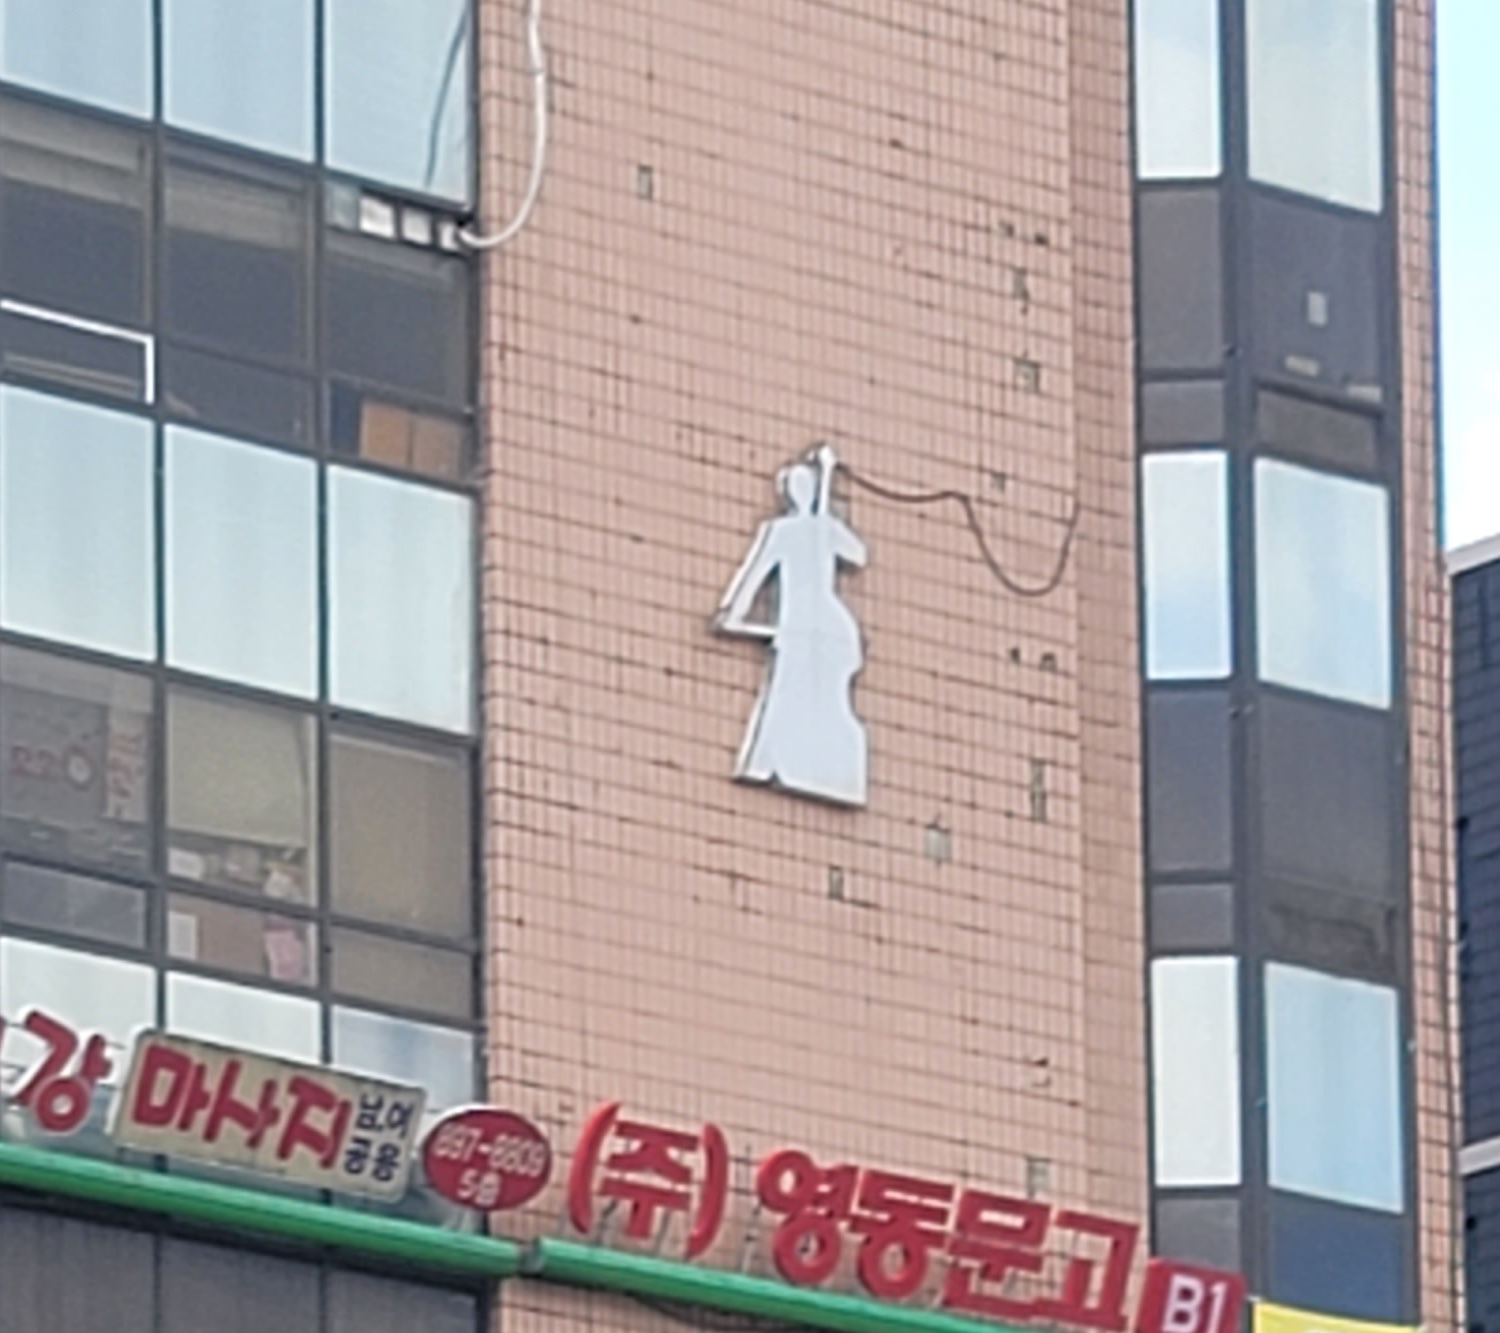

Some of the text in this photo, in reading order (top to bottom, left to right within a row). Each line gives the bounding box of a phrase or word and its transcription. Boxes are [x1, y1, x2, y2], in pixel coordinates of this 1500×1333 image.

[132, 1044, 352, 1169] 마사지
[570, 1101, 1140, 1332] (주) 영동문고
